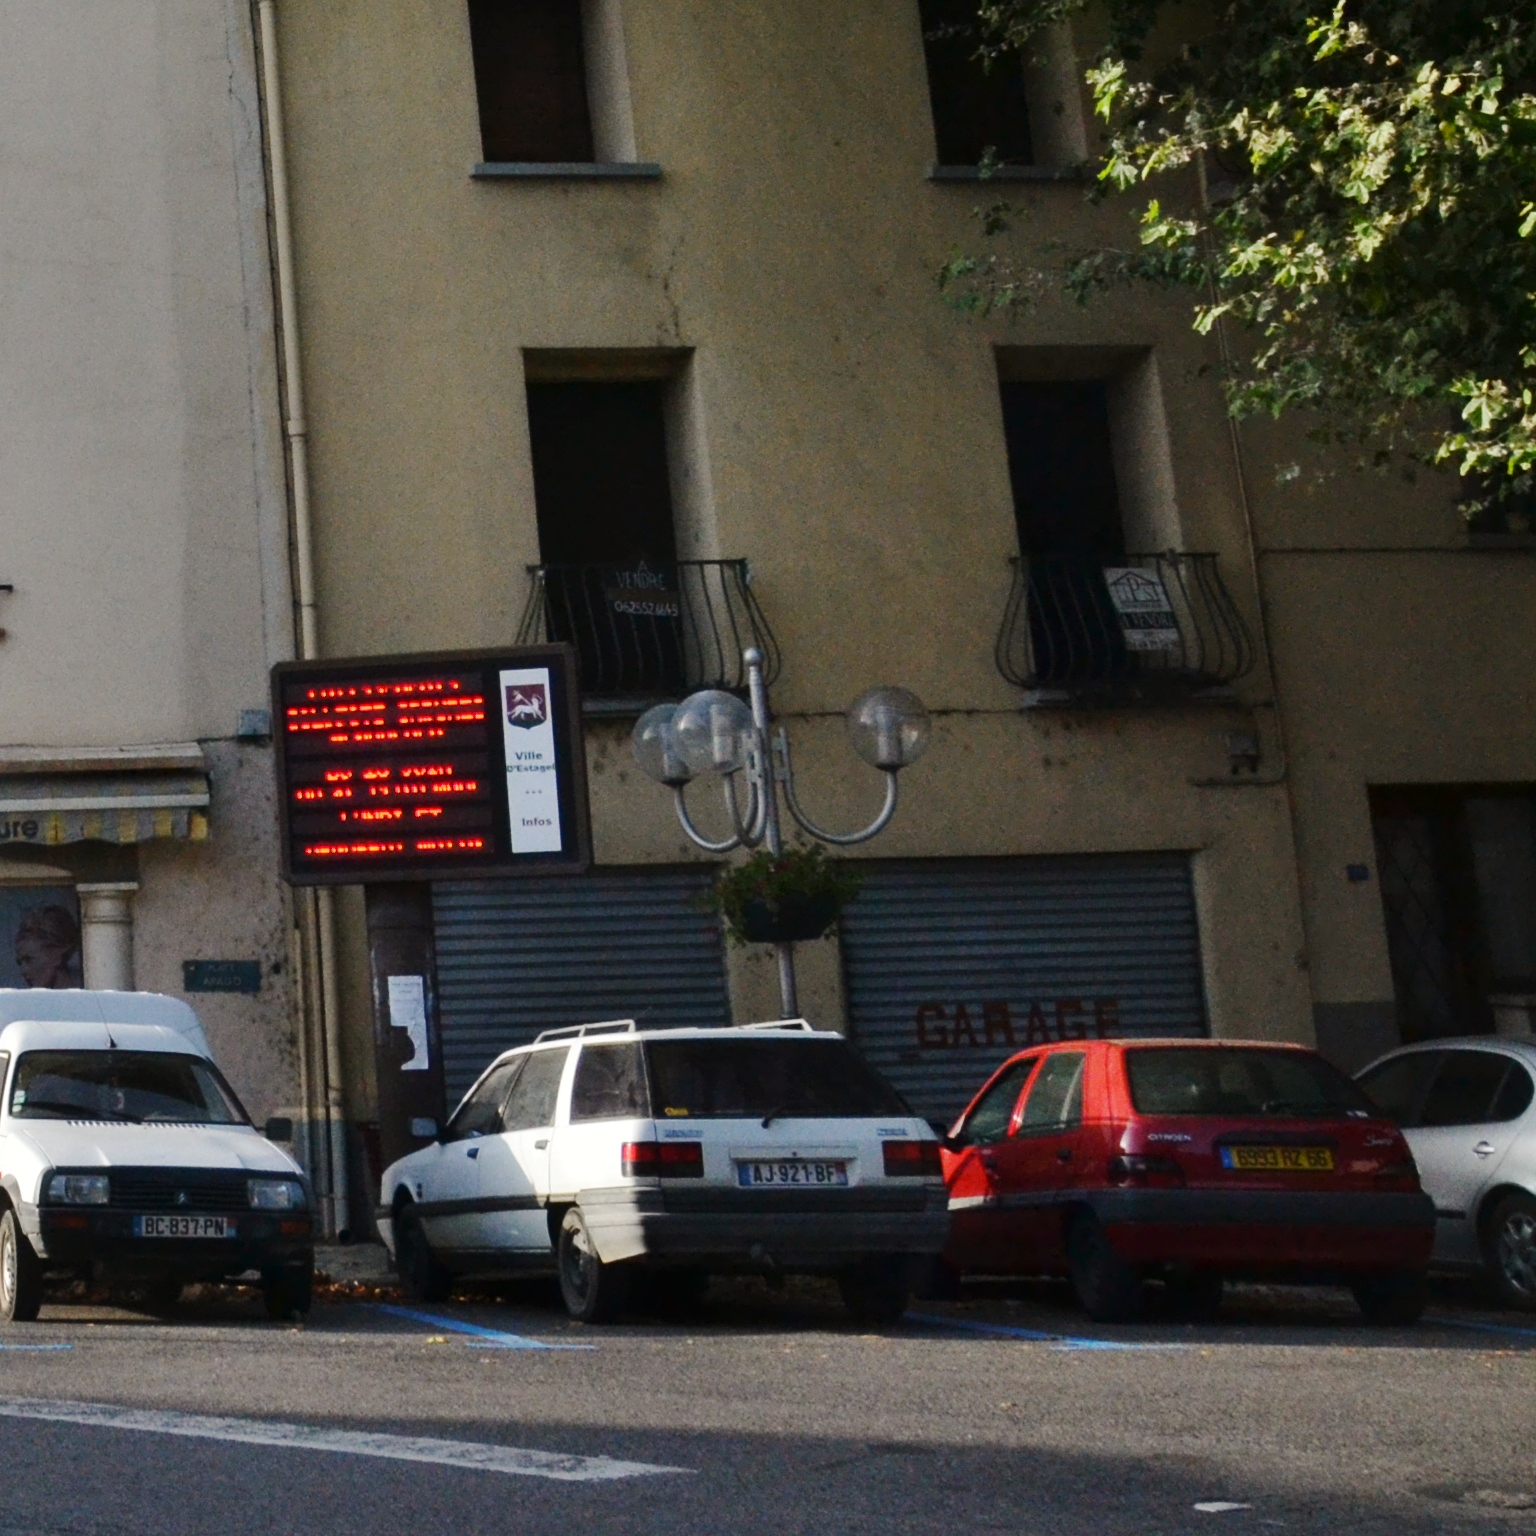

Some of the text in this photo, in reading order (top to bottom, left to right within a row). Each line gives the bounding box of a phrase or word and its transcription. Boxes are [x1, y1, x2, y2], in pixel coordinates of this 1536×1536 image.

[514, 751, 543, 761] Ville
[522, 817, 552, 827] Infos
[917, 999, 1121, 1049] GARAGE
[753, 1163, 836, 1183] AJ-921-BF
[145, 1217, 224, 1235] BC-837-PN
